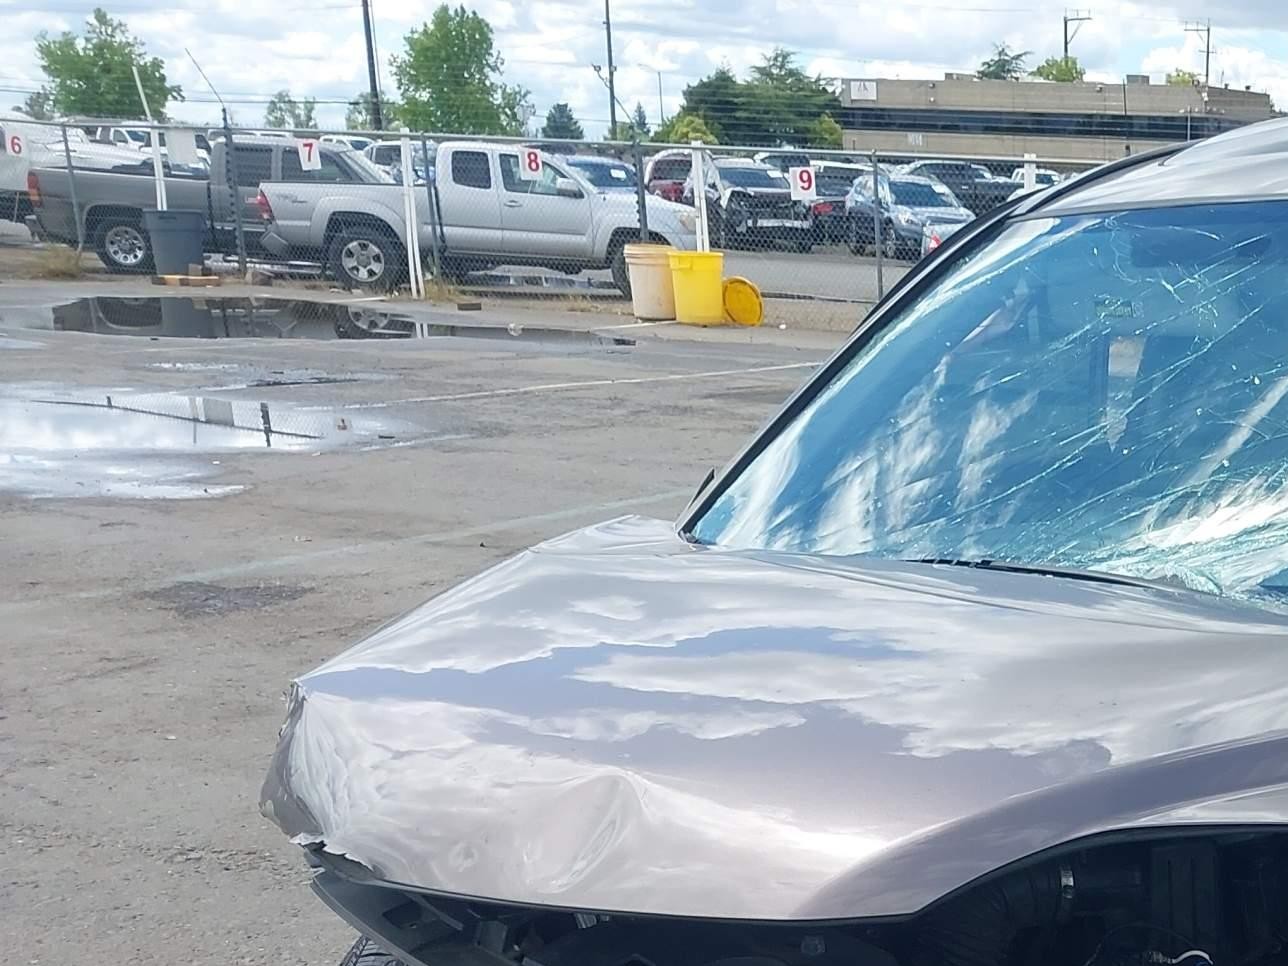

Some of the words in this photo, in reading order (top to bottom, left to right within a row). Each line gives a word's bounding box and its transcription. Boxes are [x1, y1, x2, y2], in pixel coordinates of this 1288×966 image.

[10, 135, 22, 155] 6
[302, 142, 314, 163] 7
[527, 151, 540, 172] 8
[798, 169, 813, 191] 9
